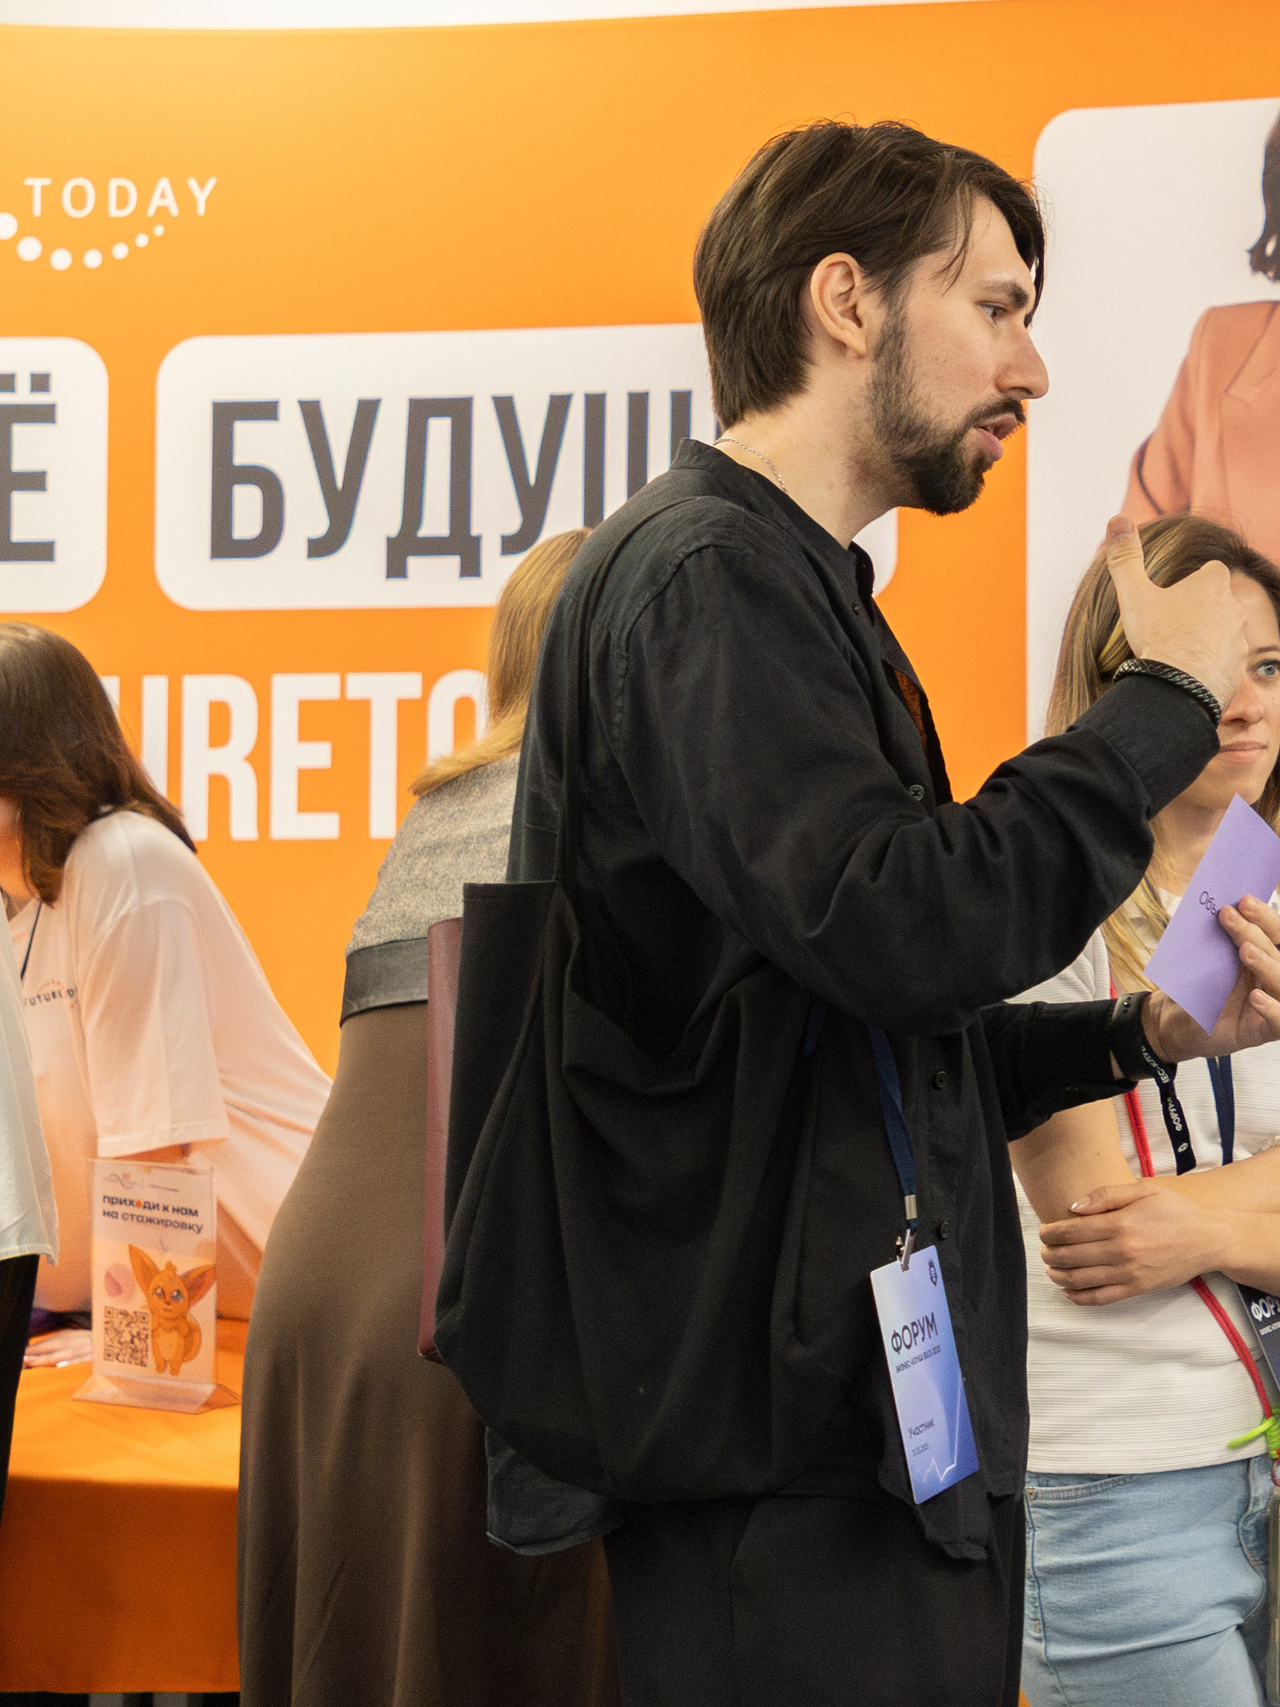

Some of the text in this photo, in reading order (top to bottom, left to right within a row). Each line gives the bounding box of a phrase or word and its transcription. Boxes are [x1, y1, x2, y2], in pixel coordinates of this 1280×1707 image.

[23, 176, 218, 218] TODAY
[209, 389, 714, 580] БУДУЩ
[102, 1195, 199, 1218] приходи к нам
[102, 1208, 203, 1234] на стажировку
[892, 1312, 938, 1353] ФОРУМ
